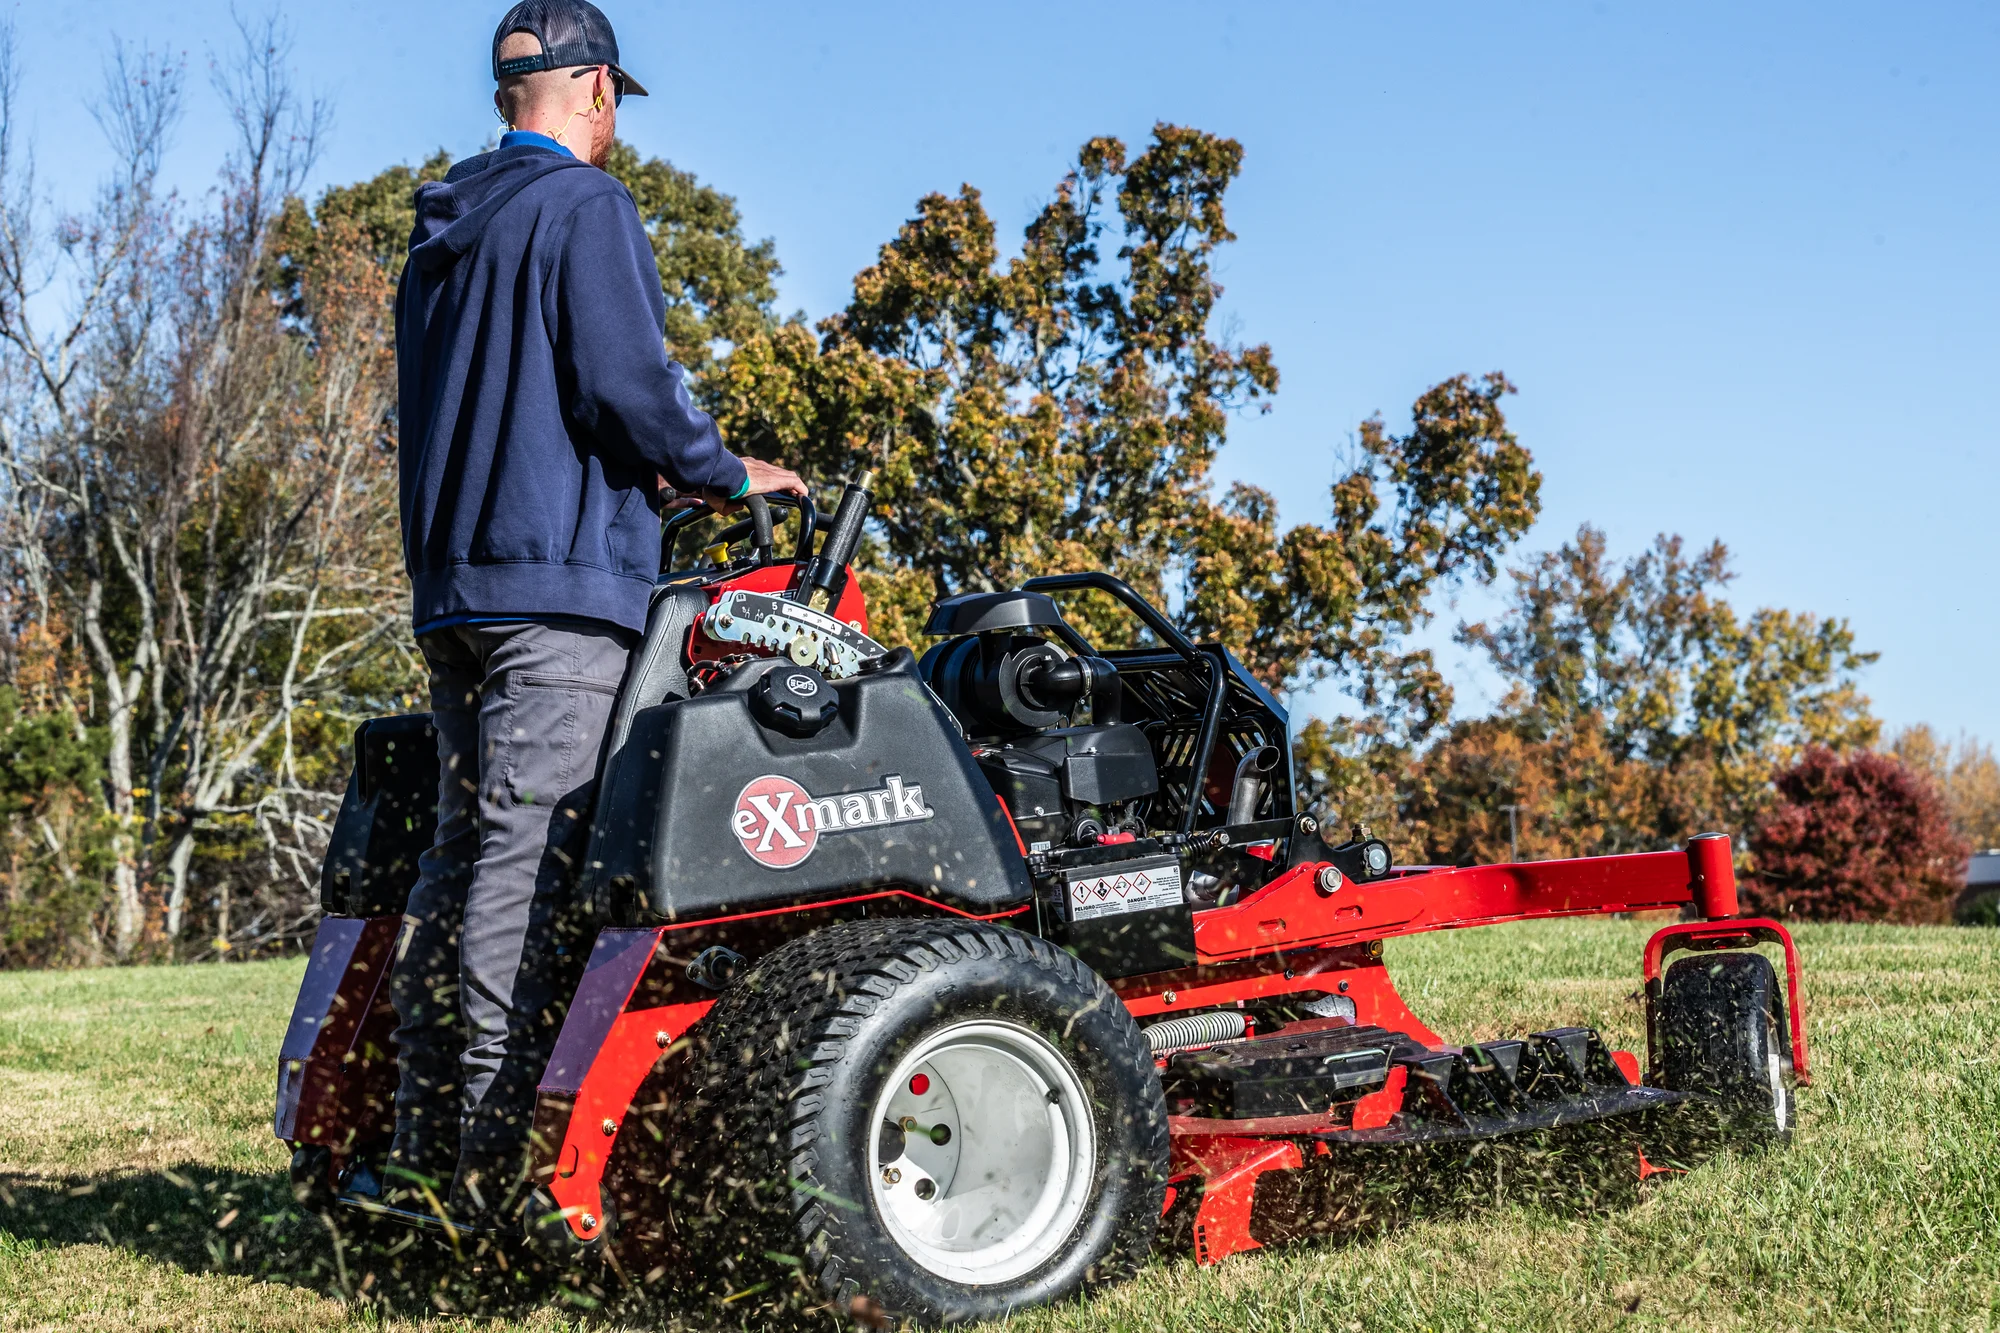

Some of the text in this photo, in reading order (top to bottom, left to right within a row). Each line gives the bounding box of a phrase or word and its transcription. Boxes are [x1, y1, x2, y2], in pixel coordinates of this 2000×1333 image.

[771, 601, 778, 610] 5
[1127, 896, 1147, 904] DANGER
[1074, 904, 1096, 912] PELIGRO
